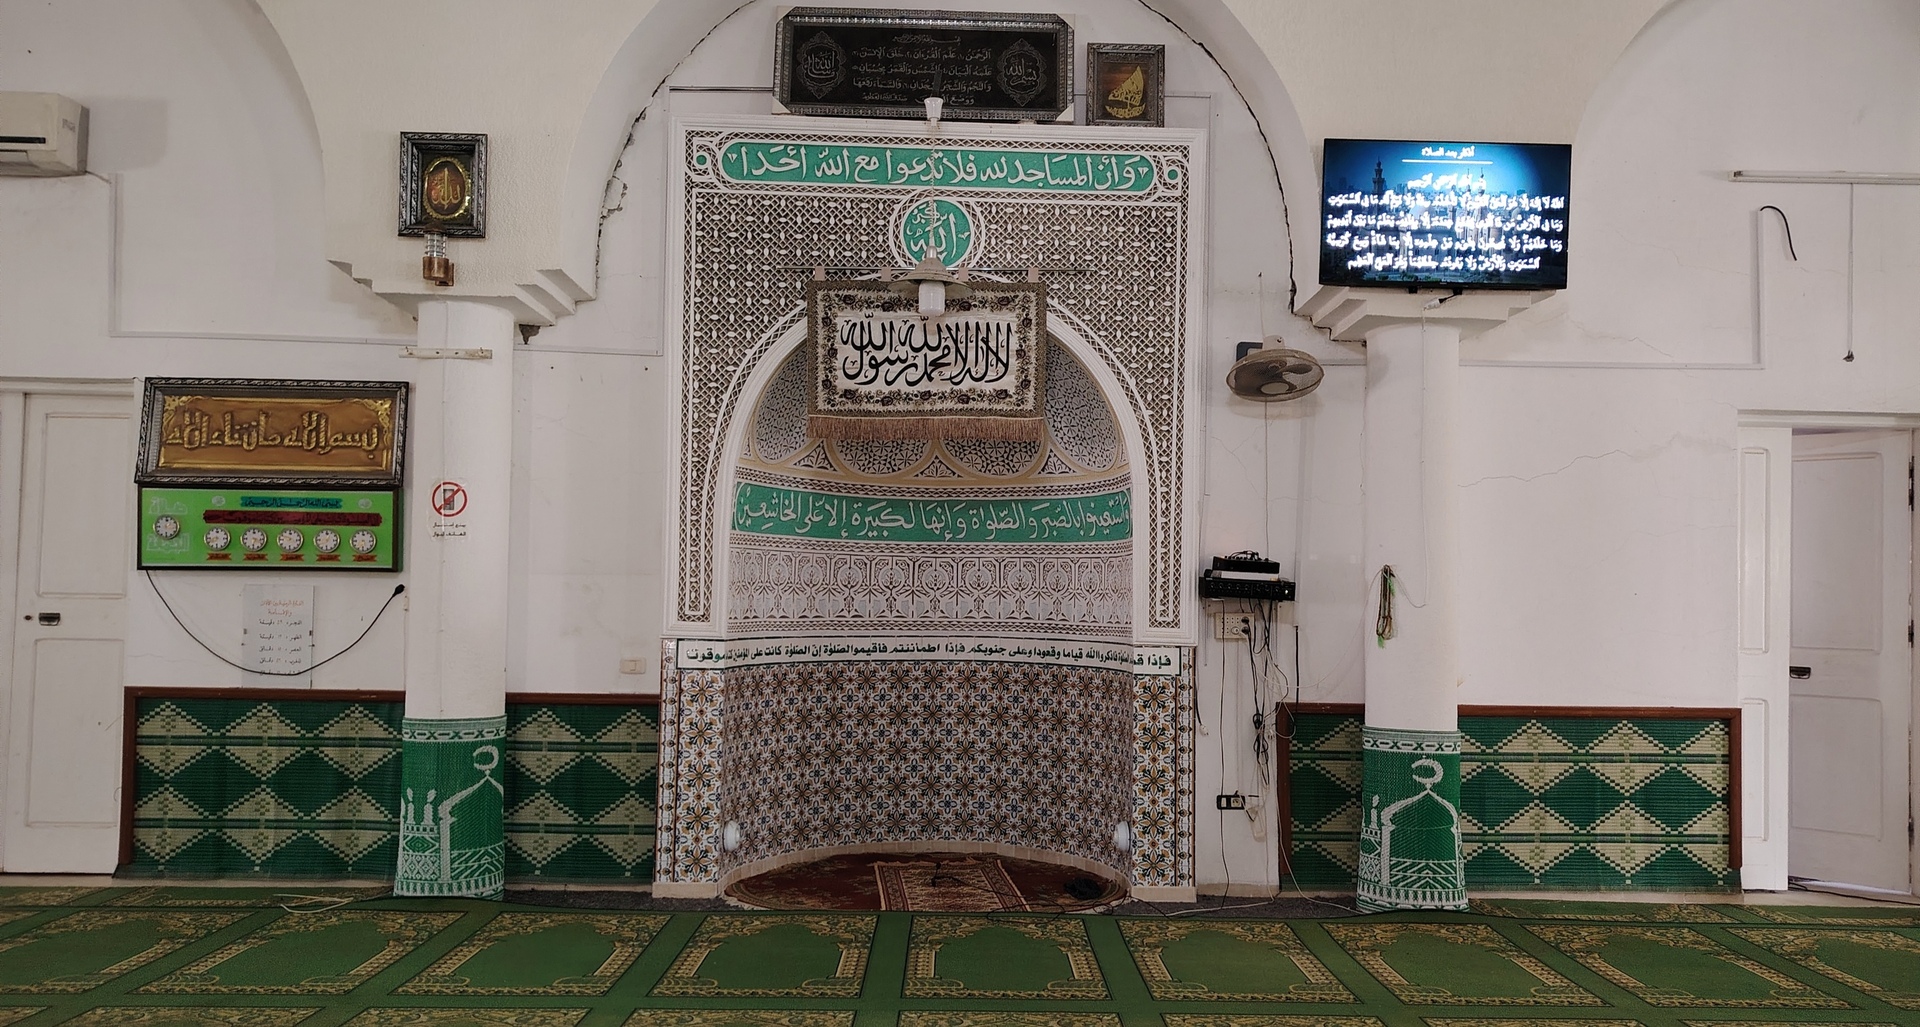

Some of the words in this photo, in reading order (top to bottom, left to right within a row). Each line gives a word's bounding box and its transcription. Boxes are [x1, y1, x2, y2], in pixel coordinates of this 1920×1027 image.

[814, 147, 851, 181] الله
[854, 153, 880, 183] مع
[942, 150, 978, 184] فلا
[980, 155, 1008, 183] لله
[1008, 152, 1094, 188] المساجد
[840, 311, 895, 352] الله
[842, 320, 918, 387] رسول
[905, 343, 952, 387] محمد
[944, 642, 966, 656] فإذا
[967, 643, 1007, 656] جنوبكم
[1062, 647, 1083, 662] قياما
[1147, 654, 1172, 669] فإذا
